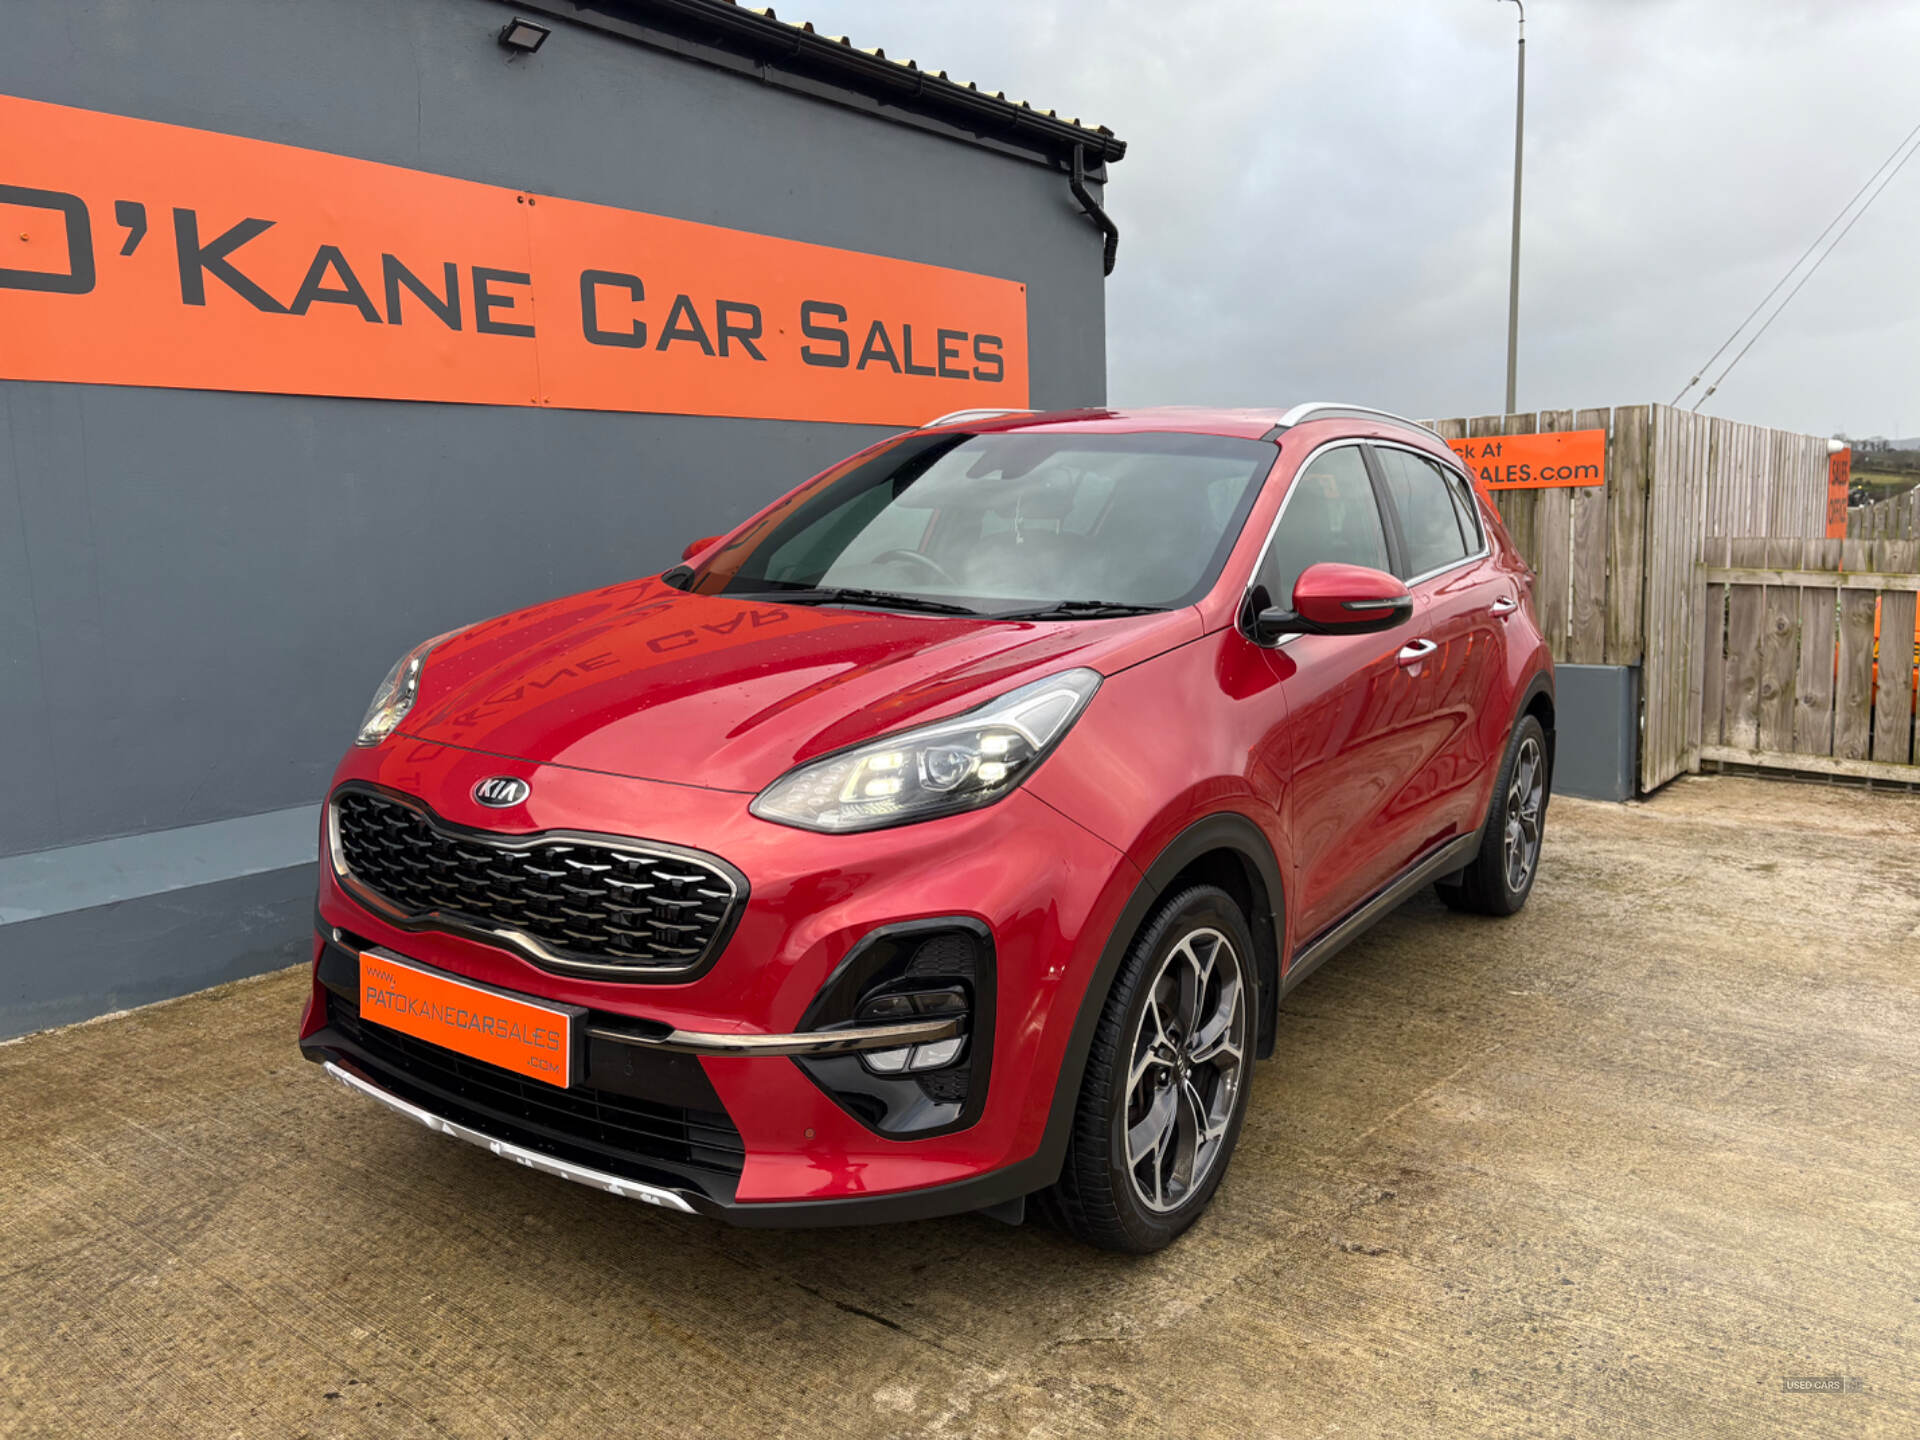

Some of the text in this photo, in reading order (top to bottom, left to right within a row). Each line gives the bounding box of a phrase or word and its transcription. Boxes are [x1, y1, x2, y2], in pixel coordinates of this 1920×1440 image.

[579, 269, 768, 361] CAR
[800, 299, 1005, 383] SALES
[1481, 442, 1503, 458] At
[1472, 464, 1599, 483] ALES.com
[478, 779, 518, 802] KIA
[366, 987, 560, 1051] PATOKANECARSALES
